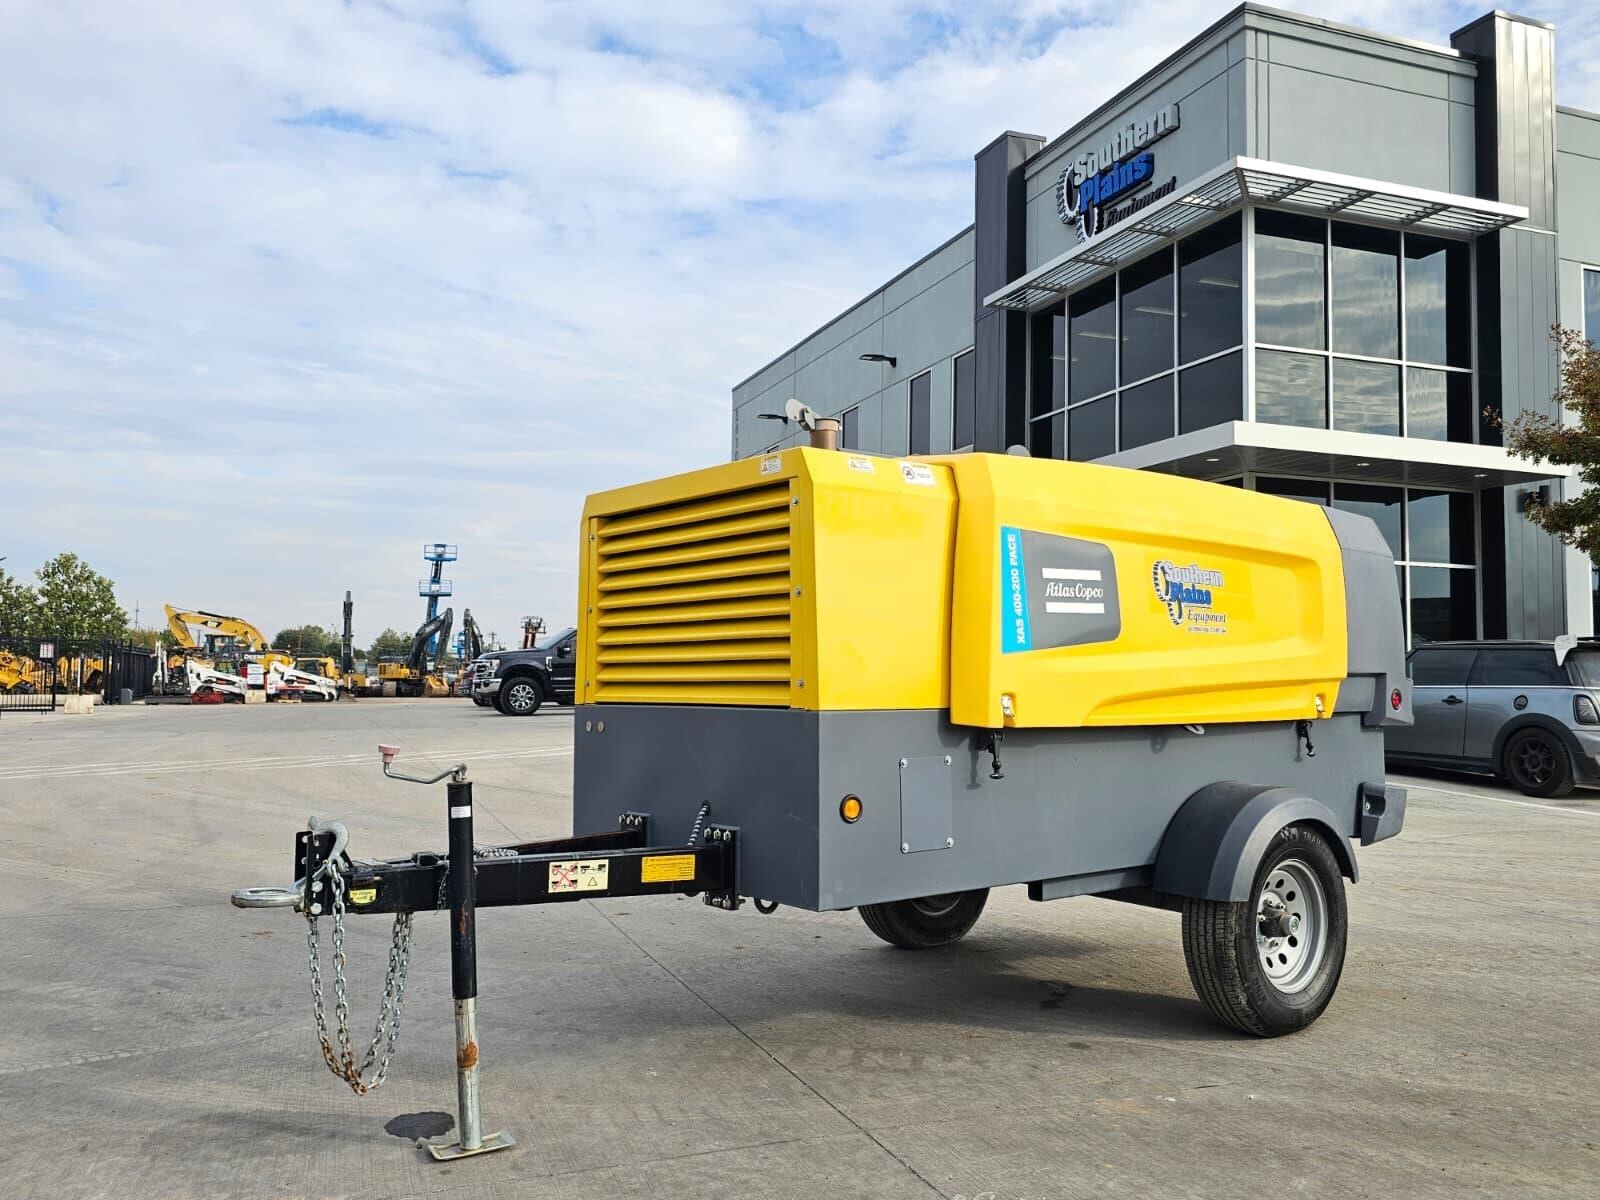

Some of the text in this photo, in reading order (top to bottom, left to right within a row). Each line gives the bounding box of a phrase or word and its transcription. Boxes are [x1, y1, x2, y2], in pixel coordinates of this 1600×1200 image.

[1073, 103, 1180, 185] Southern
[1079, 152, 1154, 214] Plains
[1163, 561, 1223, 588] Southern
[1008, 534, 1026, 645] XAS 400-200 PACE
[1044, 582, 1104, 601] Atlas Copco
[1169, 581, 1212, 605] Plains
[1187, 609, 1226, 623] Equipment
